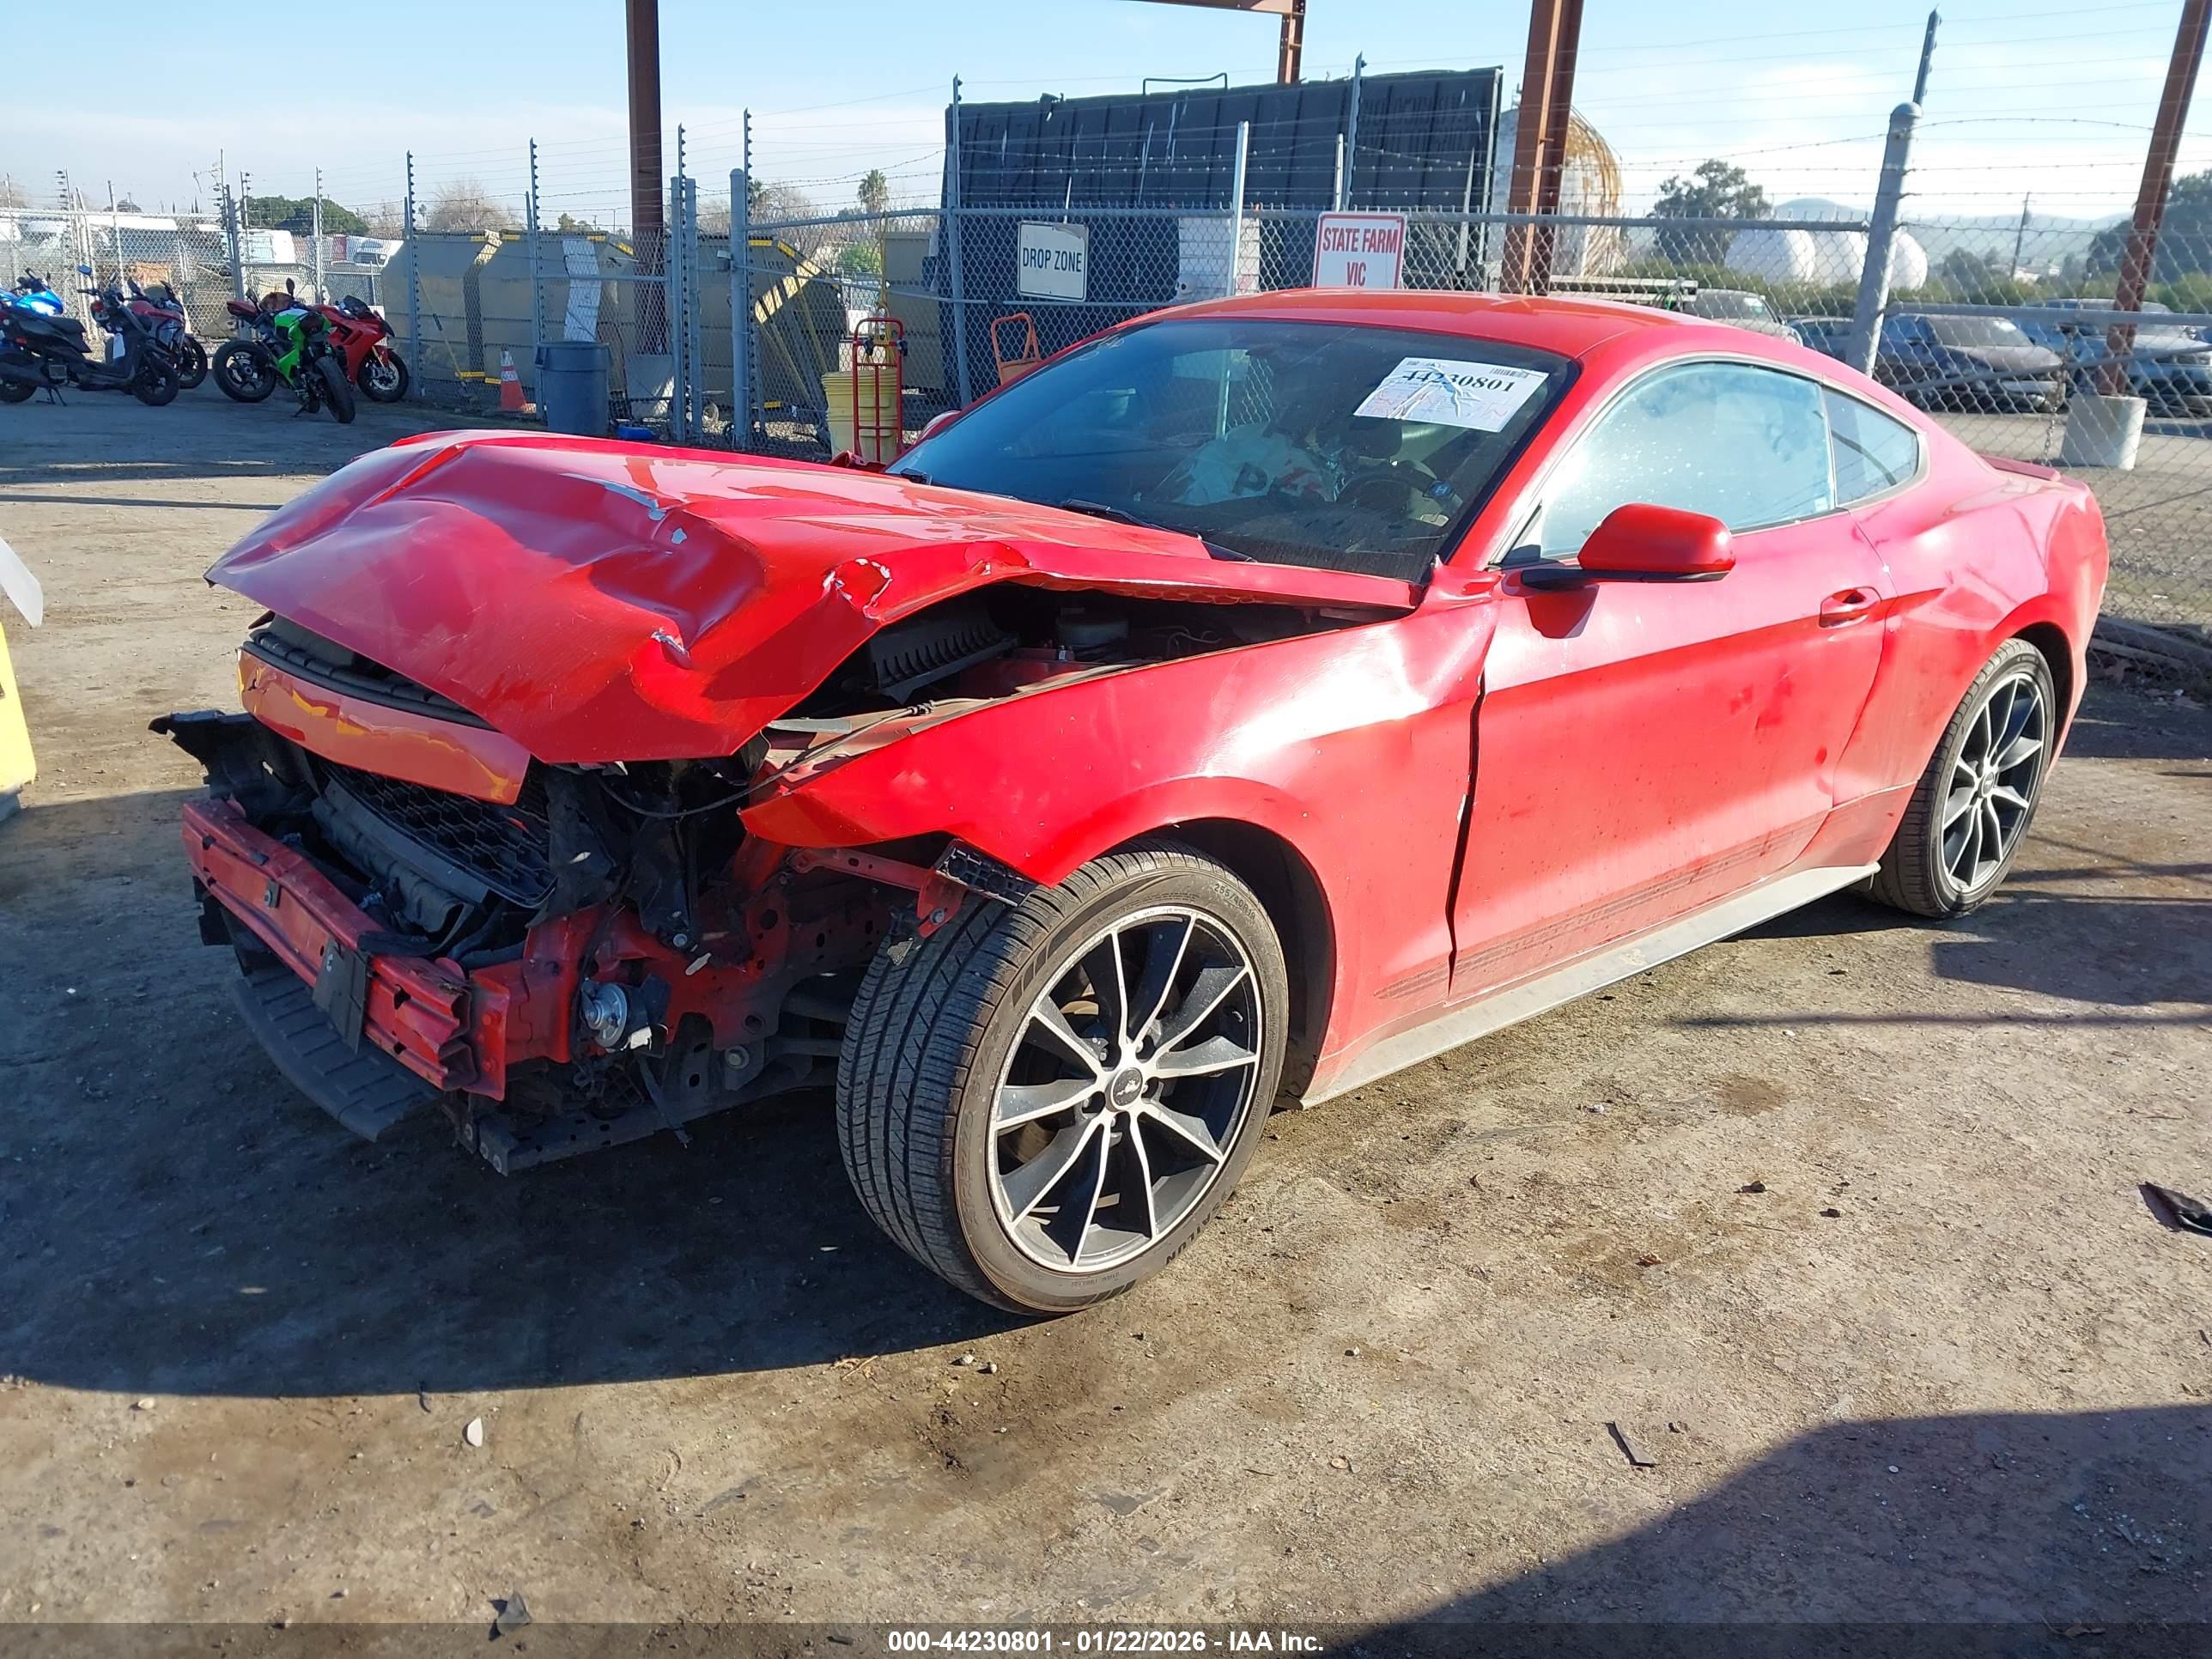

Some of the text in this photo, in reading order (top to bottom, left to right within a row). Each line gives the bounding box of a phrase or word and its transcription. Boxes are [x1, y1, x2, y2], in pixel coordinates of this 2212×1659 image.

[1322, 227, 1398, 253] STATE FARM
[1023, 247, 1082, 272] DROP ZONE
[1346, 261, 1366, 287] VIC
[1402, 369, 1516, 392] 44230801
